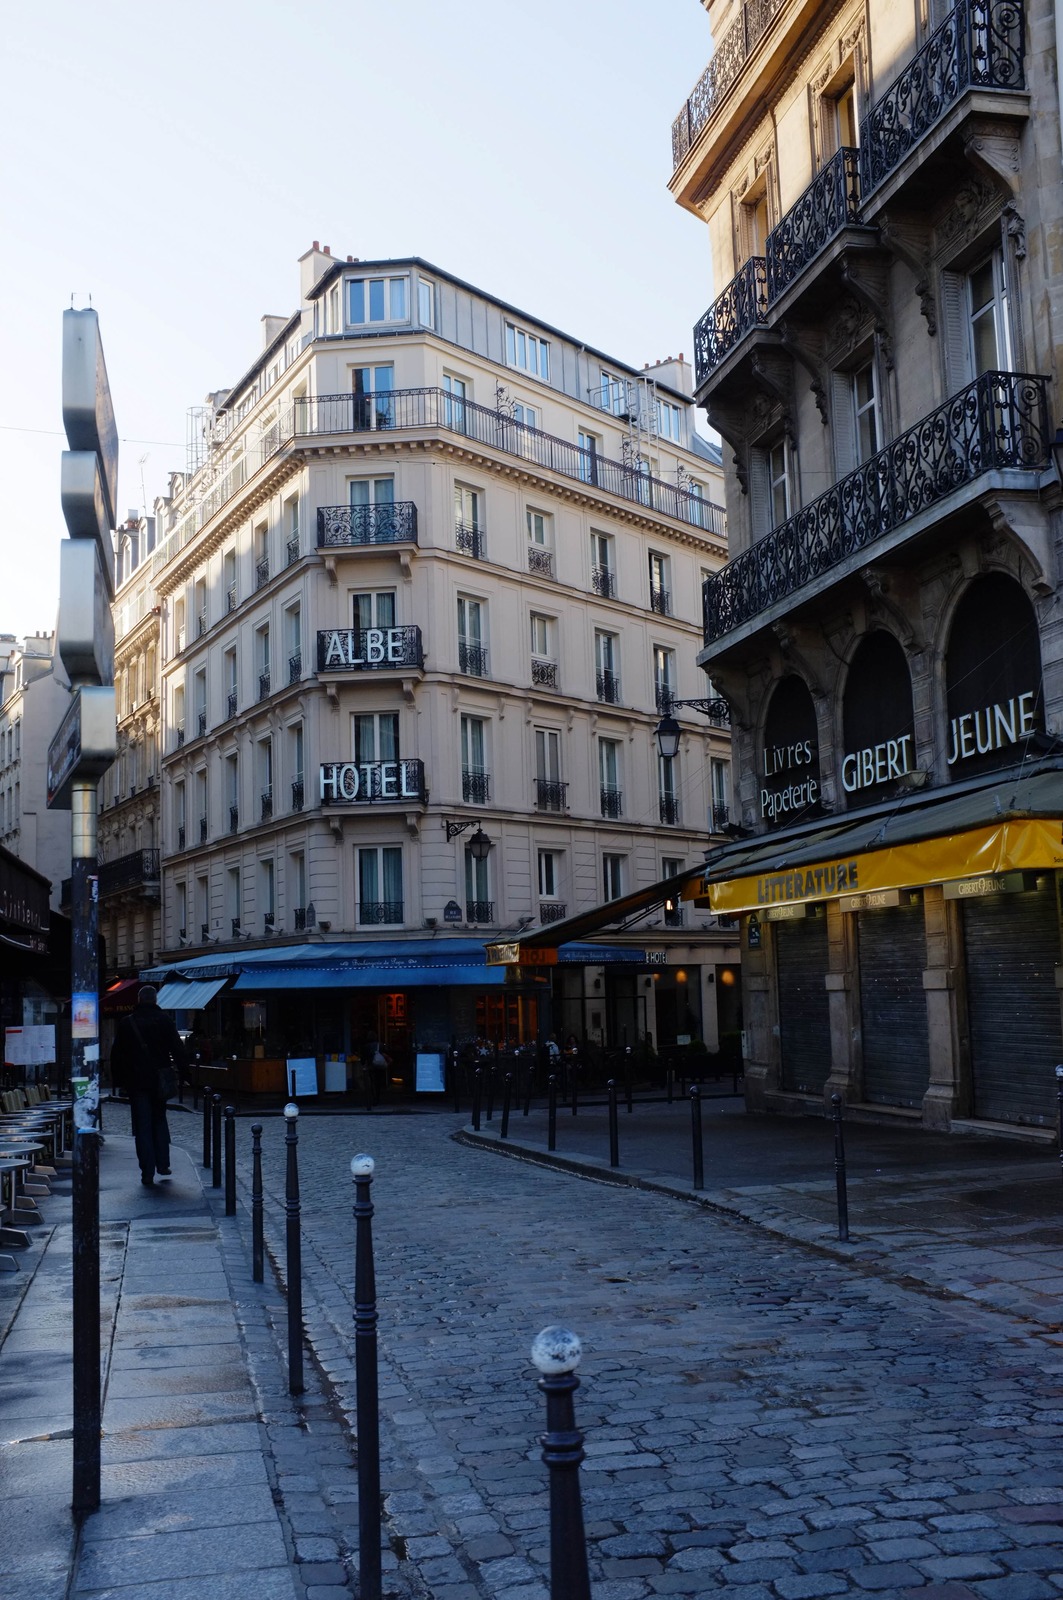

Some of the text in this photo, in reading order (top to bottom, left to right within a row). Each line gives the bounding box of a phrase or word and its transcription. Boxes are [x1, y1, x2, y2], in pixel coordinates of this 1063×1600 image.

[325, 628, 404, 665] ALBE
[763, 739, 812, 777] Livres
[842, 691, 1036, 793] GIBERT JEUNE
[319, 762, 419, 800] HOTEL
[760, 777, 819, 823] Papeterie
[757, 860, 859, 904] LITTERATURE
[958, 878, 1006, 895] GIBERT JEUNE
